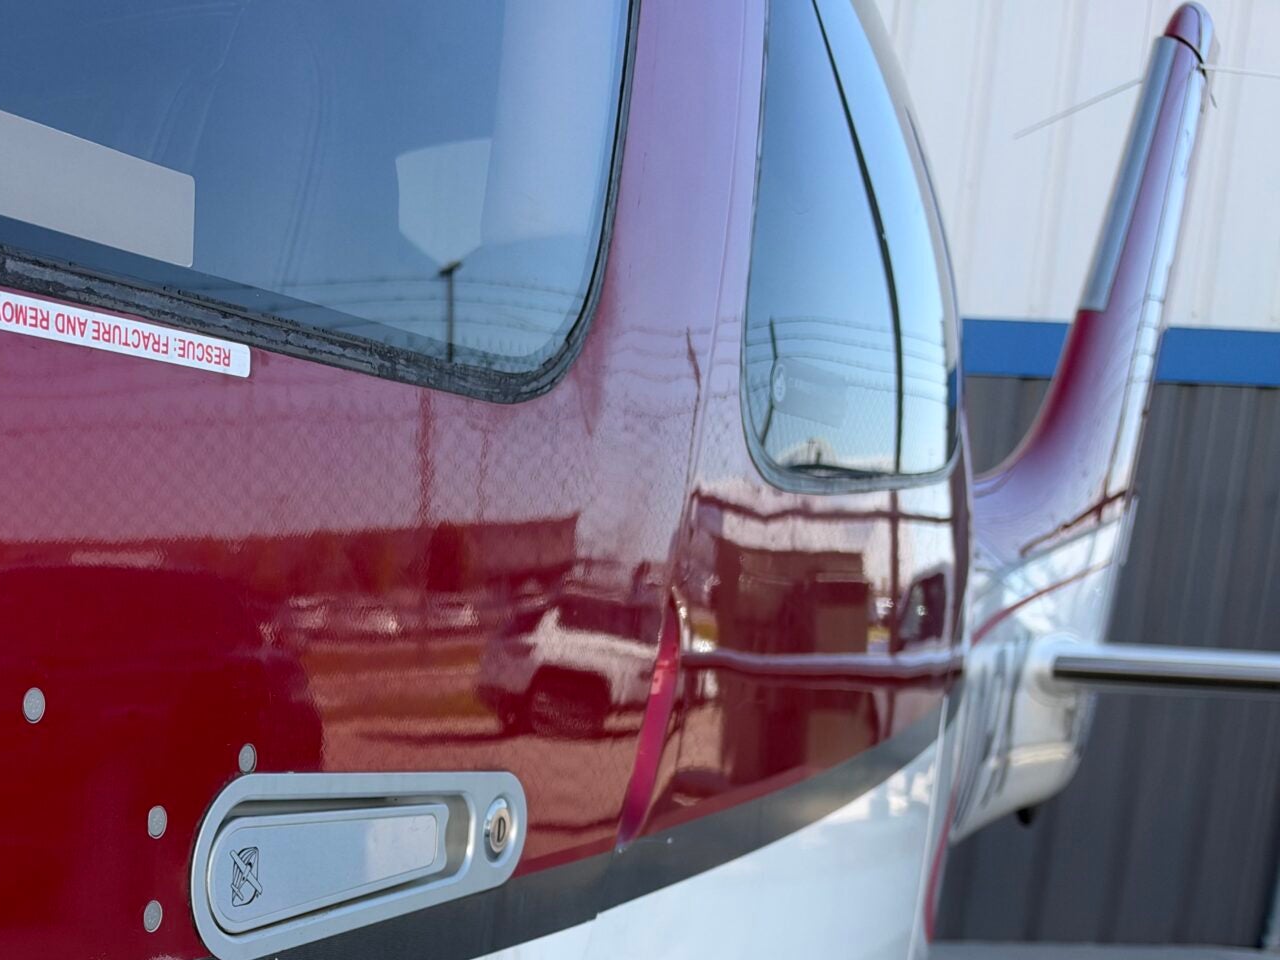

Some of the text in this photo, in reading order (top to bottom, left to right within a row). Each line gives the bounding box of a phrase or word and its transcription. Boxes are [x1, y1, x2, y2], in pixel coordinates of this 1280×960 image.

[54, 312, 88, 338] AND
[91, 320, 169, 354] FRACTURE
[173, 338, 232, 367] RESCUE:
